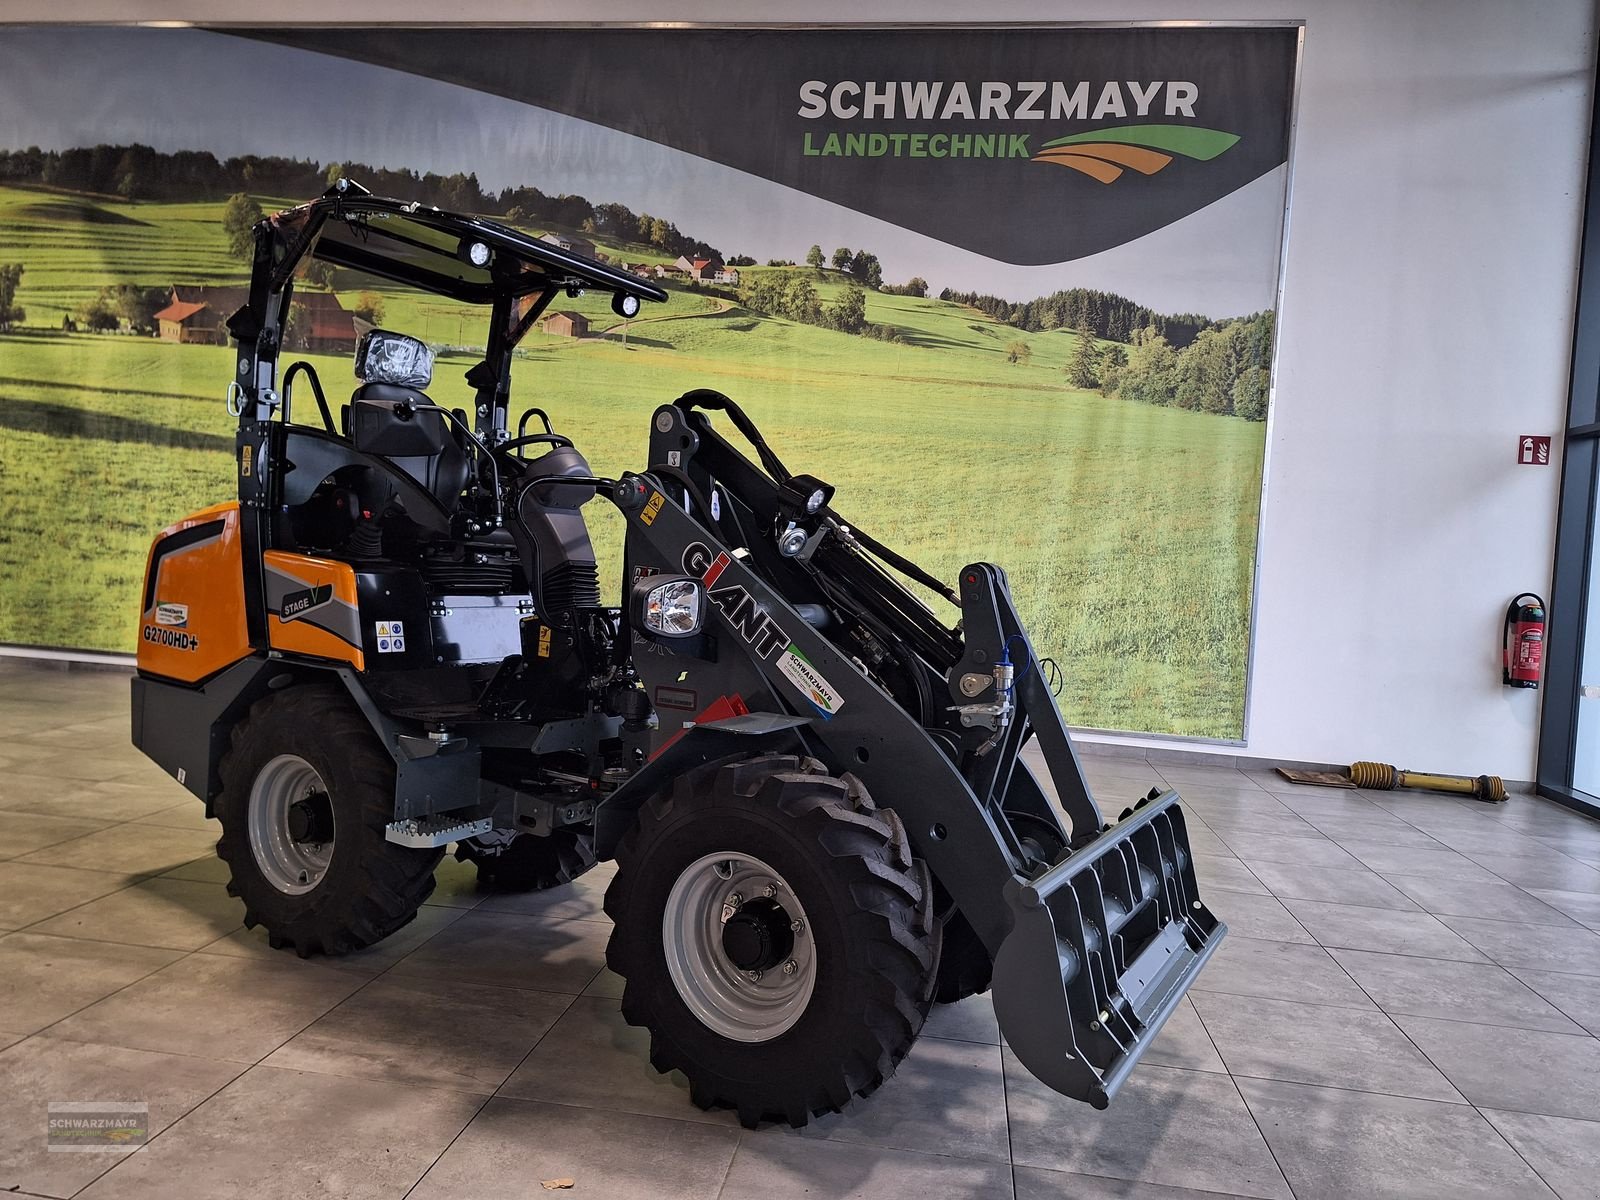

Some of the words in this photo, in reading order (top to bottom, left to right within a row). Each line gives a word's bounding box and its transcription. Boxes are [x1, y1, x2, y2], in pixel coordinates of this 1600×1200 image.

[798, 80, 1199, 120] SCHWARZMAYR
[803, 132, 1030, 158] LANDTECHNIK
[284, 598, 310, 616] STAGE
[681, 541, 792, 660] GIANT
[143, 625, 199, 651] G2700HD+
[789, 654, 833, 702] SCHWARZMAYR
